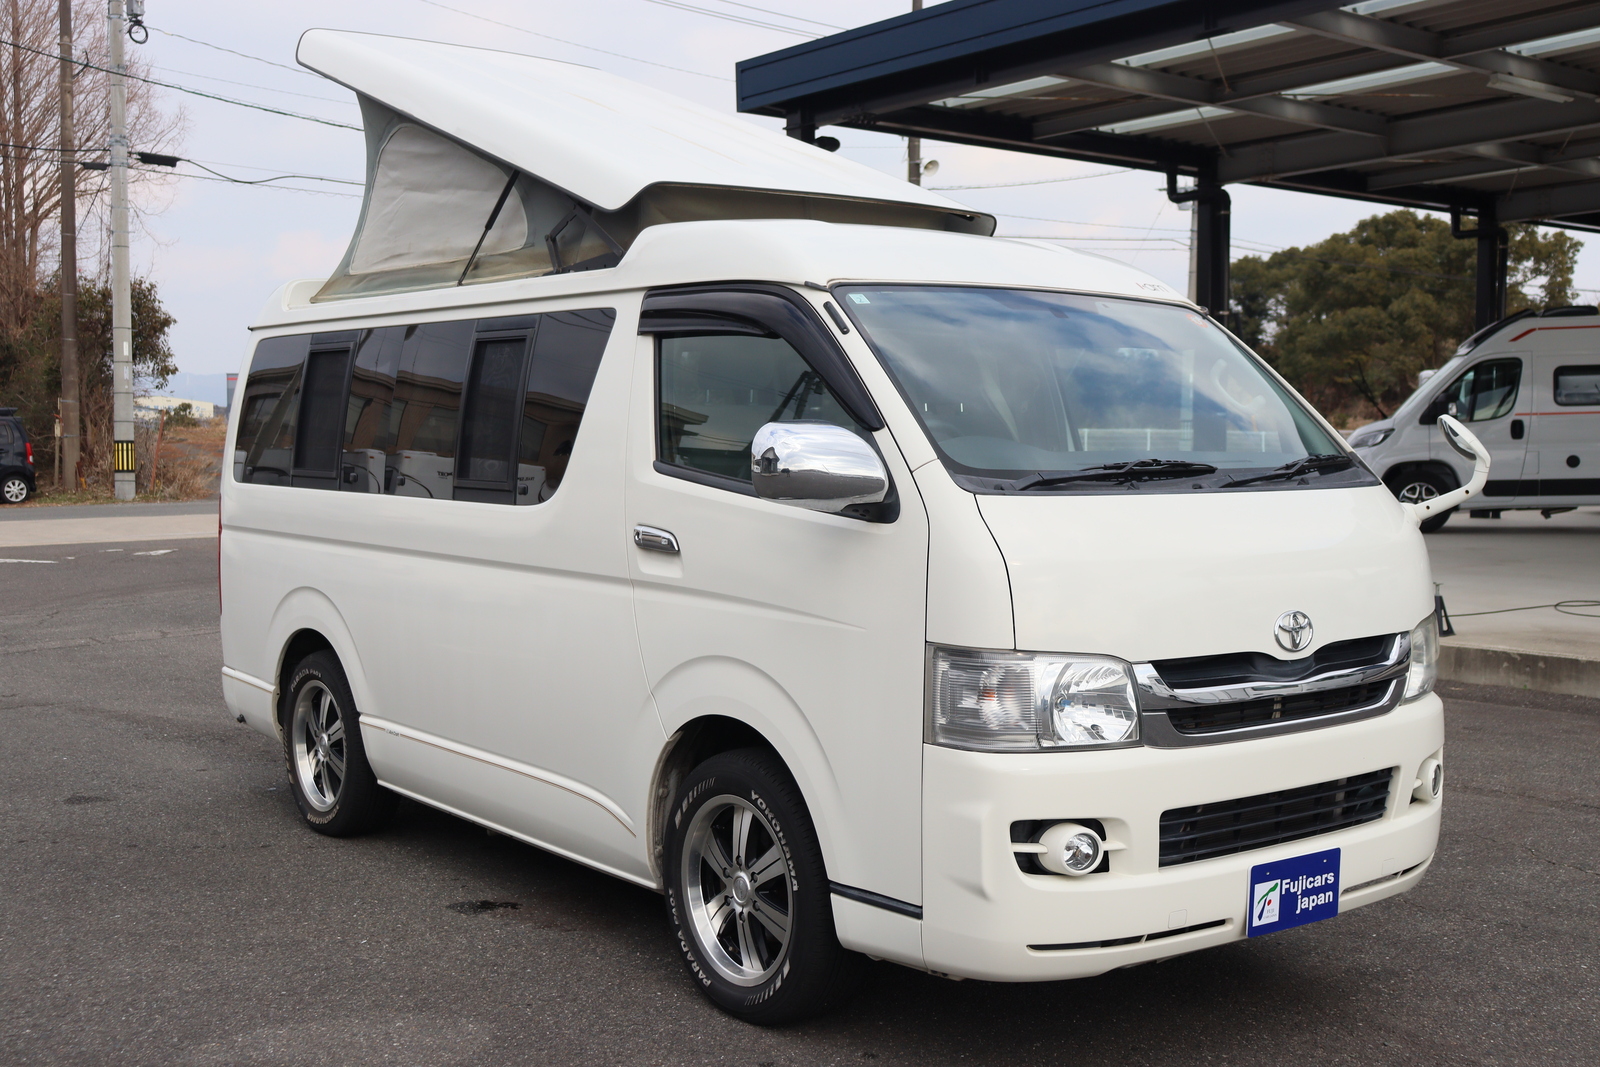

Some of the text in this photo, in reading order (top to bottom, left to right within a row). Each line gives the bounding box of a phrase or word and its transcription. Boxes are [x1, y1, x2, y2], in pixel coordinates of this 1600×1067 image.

[751, 789, 799, 892] YOKOHAMA
[1281, 872, 1335, 895] Fujicars
[1295, 890, 1334, 914] japan
[677, 929, 712, 988] PARADA
